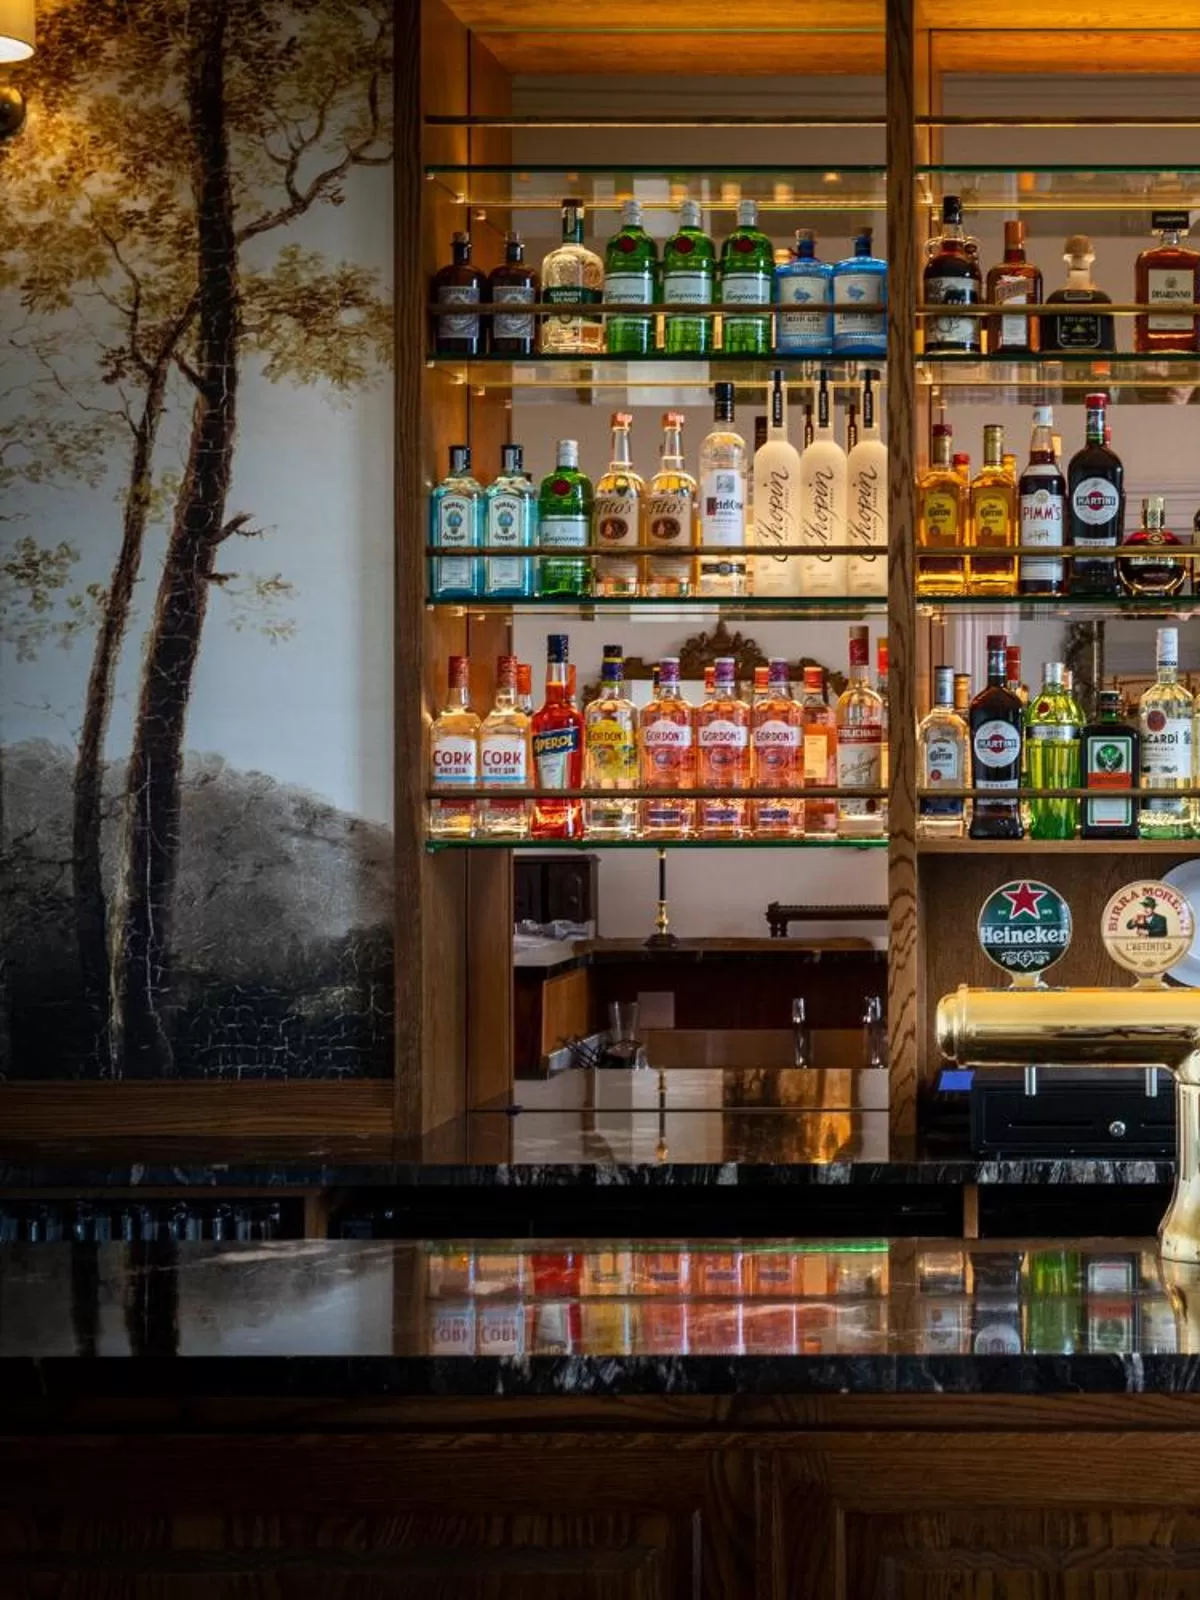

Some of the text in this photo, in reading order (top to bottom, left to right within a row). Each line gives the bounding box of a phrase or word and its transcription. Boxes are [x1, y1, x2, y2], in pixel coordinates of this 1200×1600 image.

[597, 498, 633, 513] Tito's
[648, 498, 685, 513] Tito's
[1077, 496, 1116, 506] MARTINI
[1023, 505, 1061, 520] PIMM'S
[534, 734, 574, 754] APEROL
[977, 739, 1017, 748] MARTINI
[433, 750, 472, 766] CORK
[483, 750, 522, 766] CORK
[1106, 890, 1140, 932] BIRRA
[981, 925, 1069, 945] Heineken
